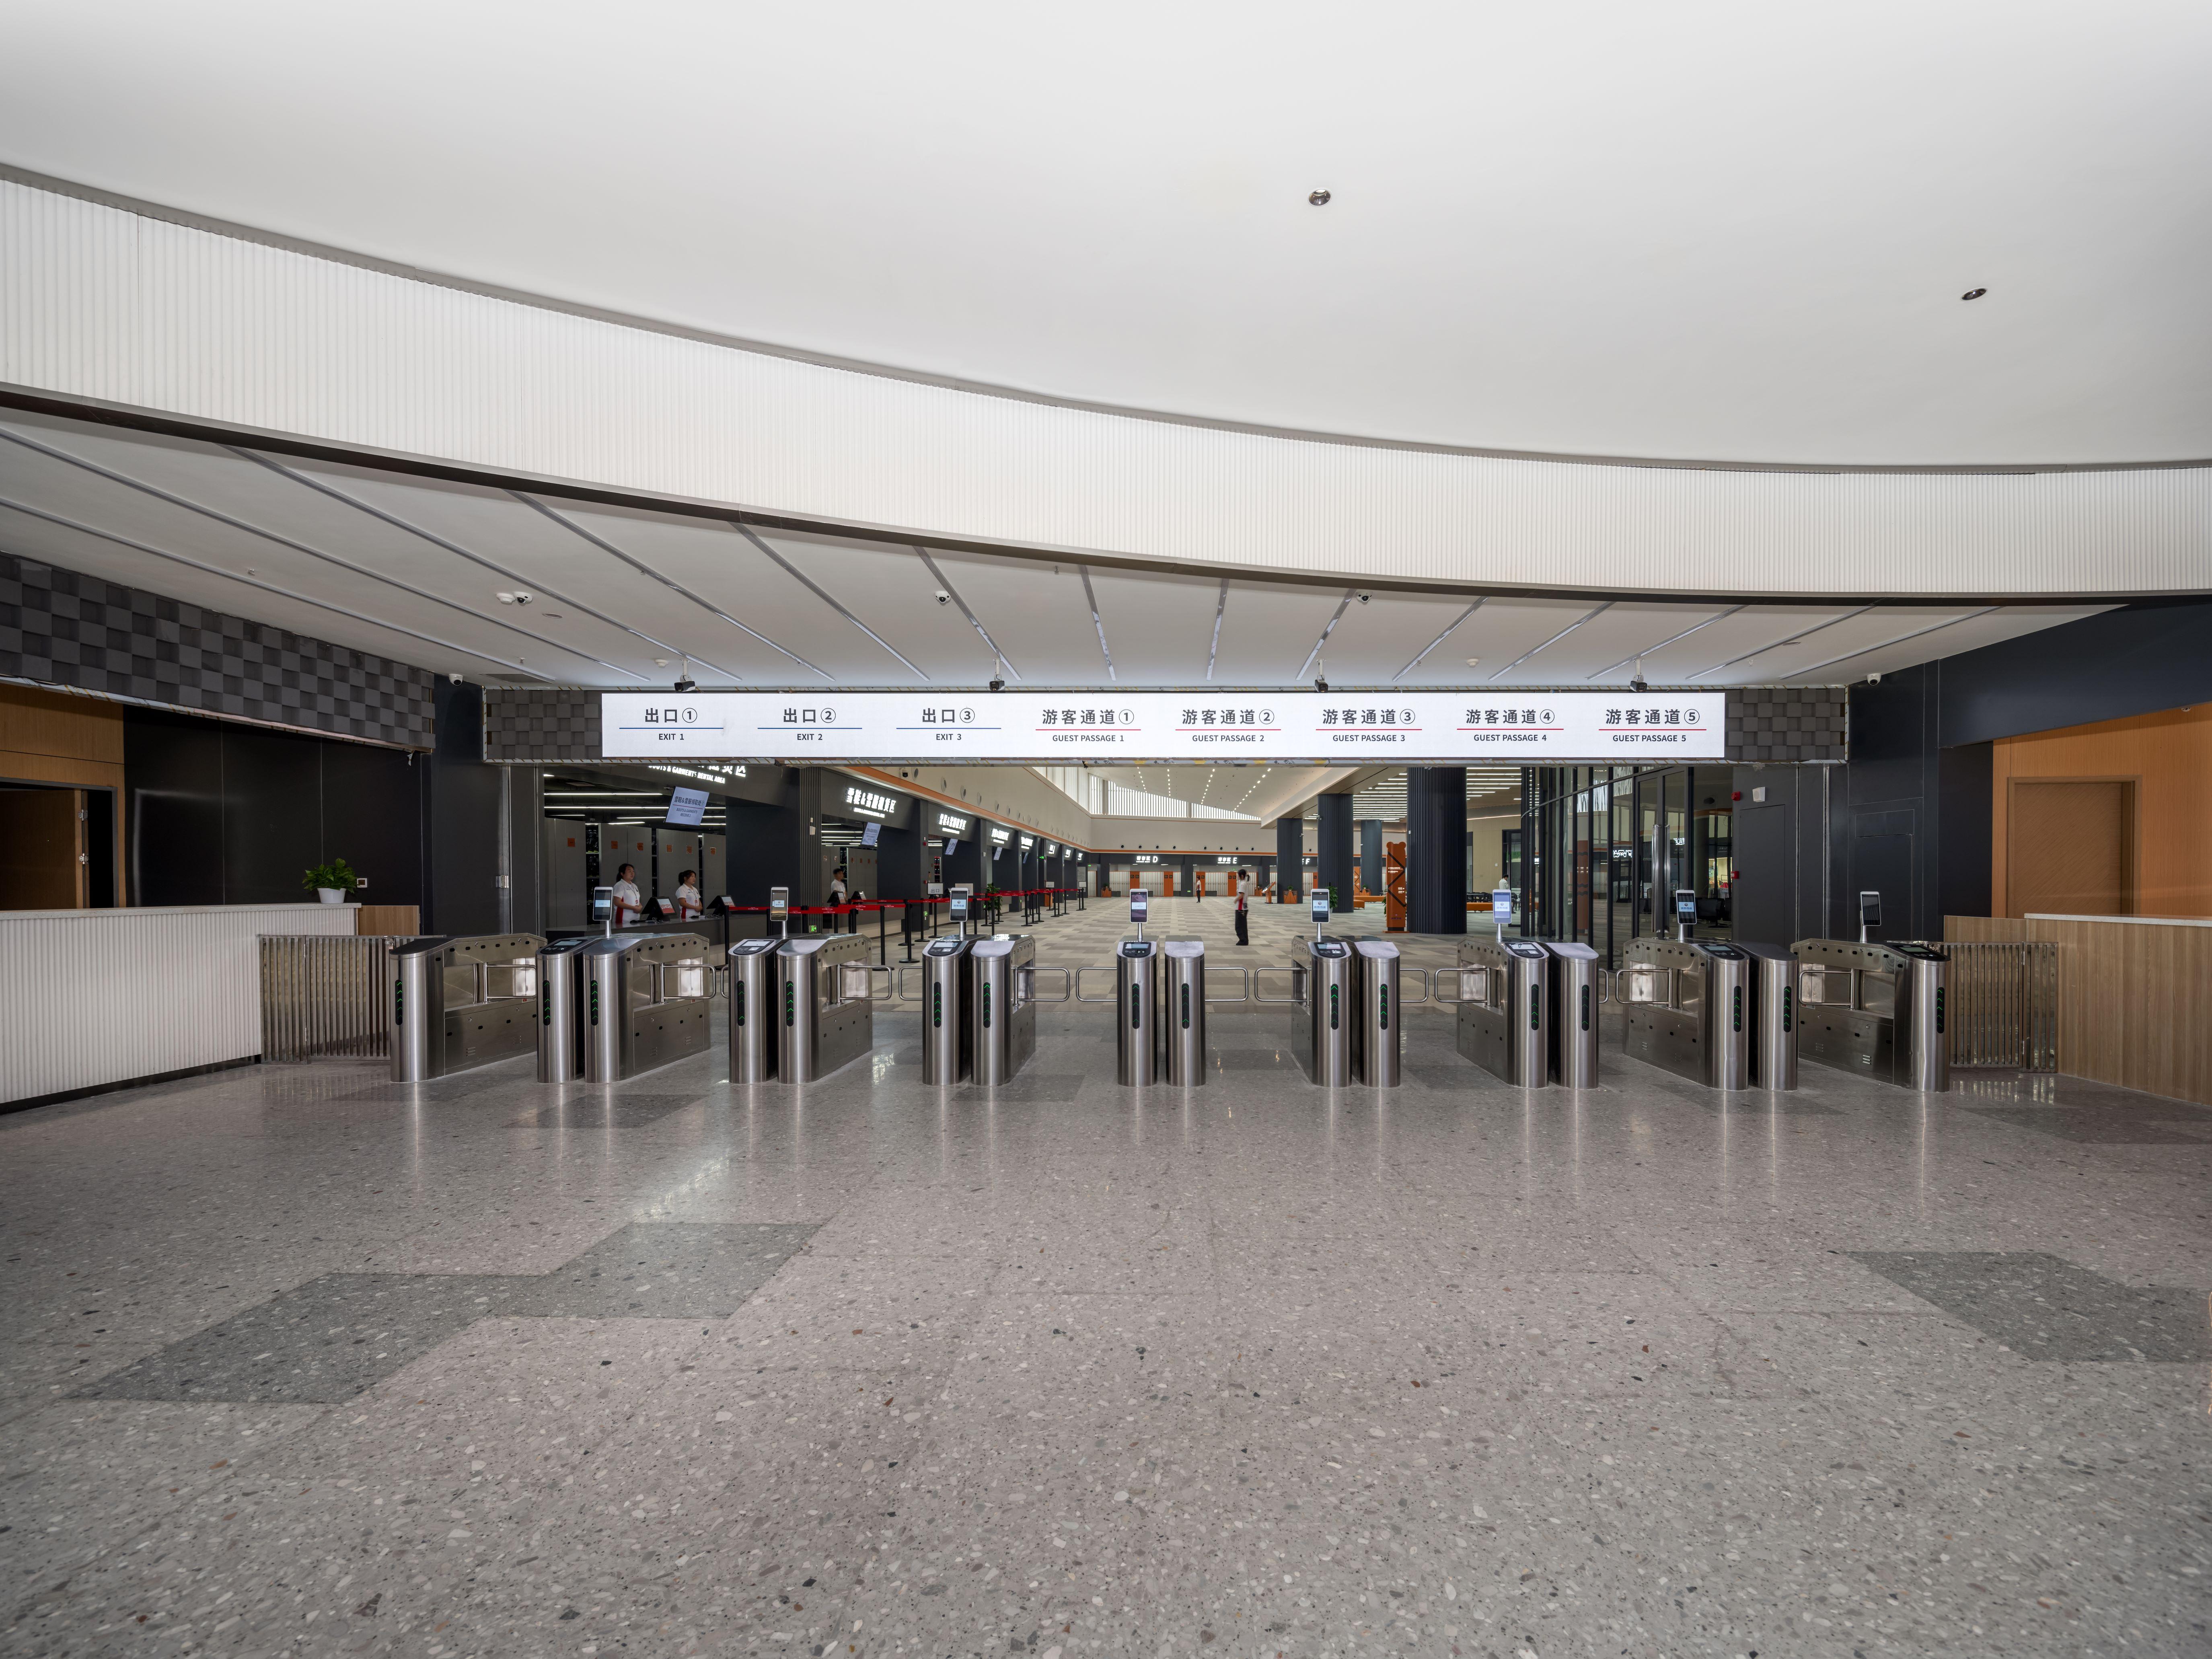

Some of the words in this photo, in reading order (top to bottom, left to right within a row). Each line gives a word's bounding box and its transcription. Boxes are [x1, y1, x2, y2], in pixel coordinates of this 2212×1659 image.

[645, 707, 697, 723] 出口①
[783, 707, 836, 724] 出口②
[922, 708, 975, 723] 出口③
[1042, 709, 1134, 724] 游客通道①
[1182, 709, 1275, 724] 游客通道②
[1323, 709, 1415, 724] 游客通道③
[1466, 709, 1555, 724] 游客通道④
[1606, 709, 1700, 725] 游客通道⑤
[672, 767, 697, 777] GARMENTS
[697, 772, 713, 781] RENTAL
